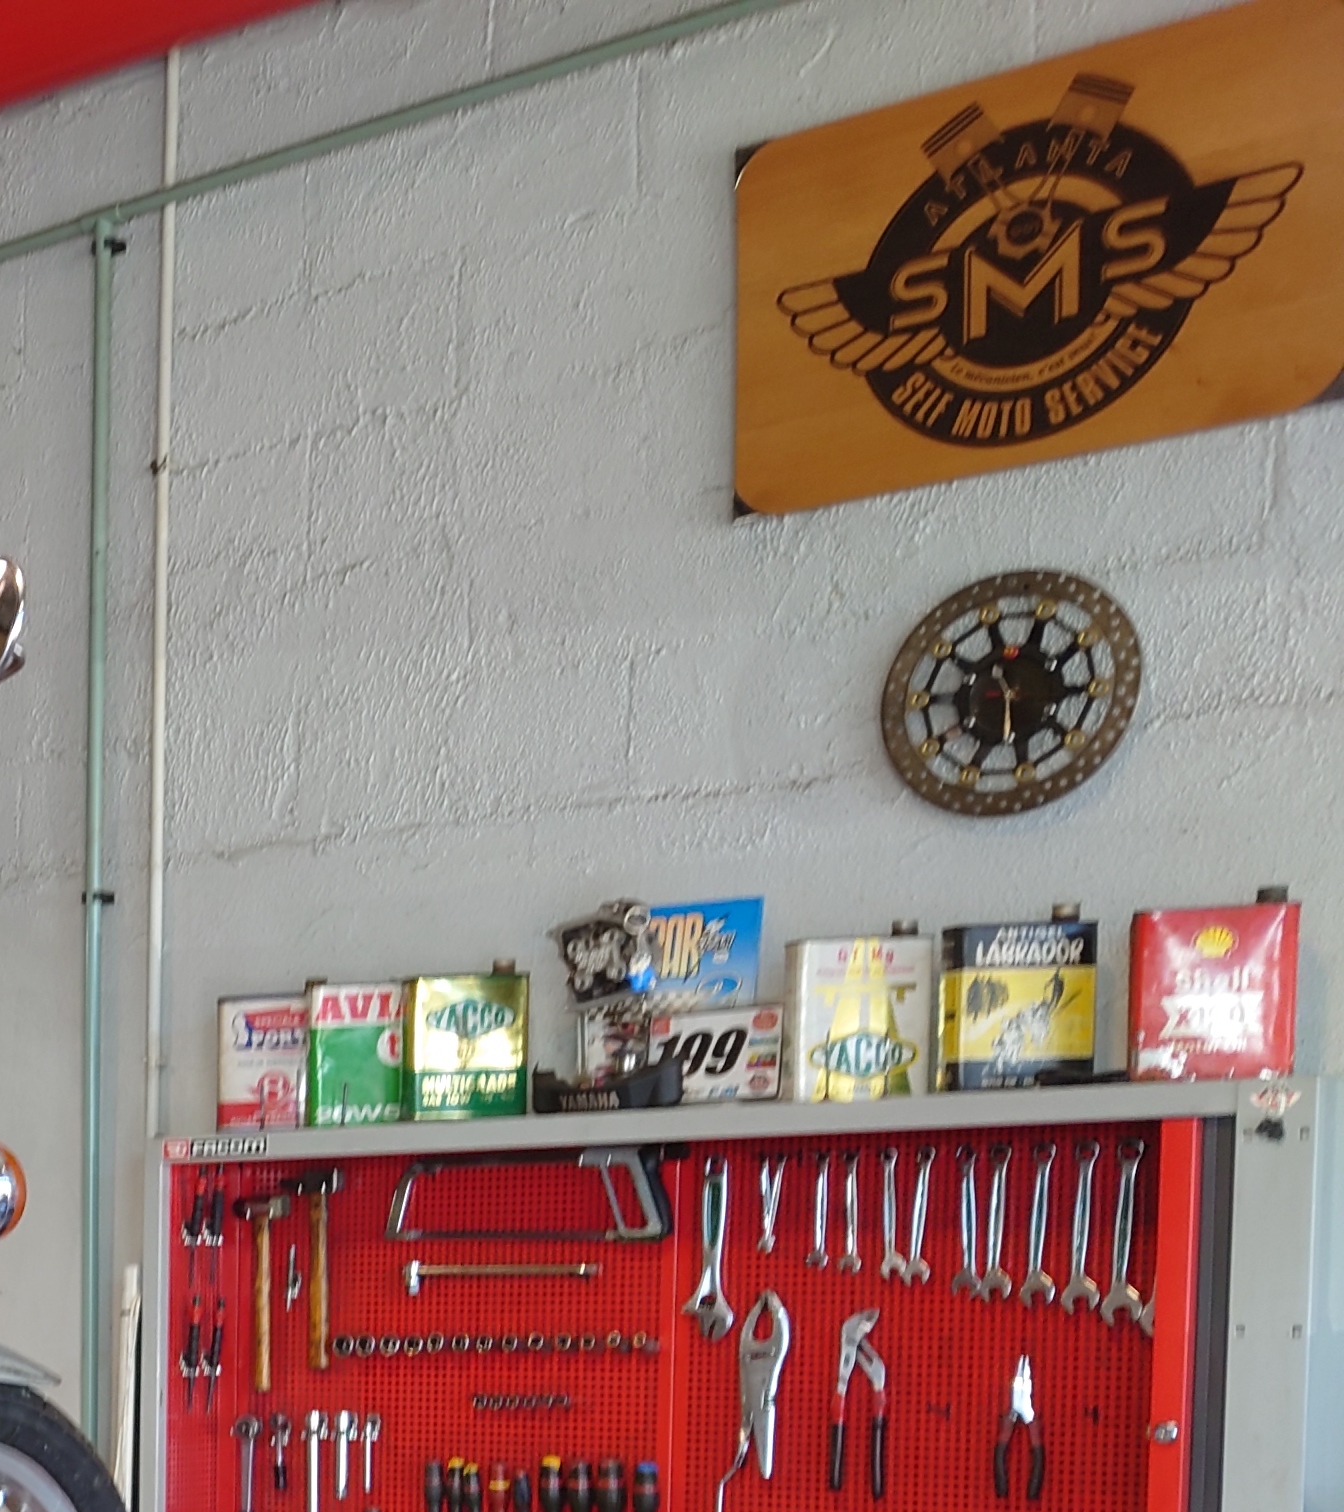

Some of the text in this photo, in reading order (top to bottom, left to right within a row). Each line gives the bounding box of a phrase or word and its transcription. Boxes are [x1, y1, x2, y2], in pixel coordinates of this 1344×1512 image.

[924, 136, 1133, 227] ATLANTA
[889, 195, 1168, 346] SMS
[891, 323, 1163, 439] SELF MOTO SERVICE
[975, 936, 1084, 966] LABRADOR
[431, 998, 509, 1038] YACCO
[559, 1090, 620, 1112] YAMAHA
[192, 1137, 266, 1158] FACOM
